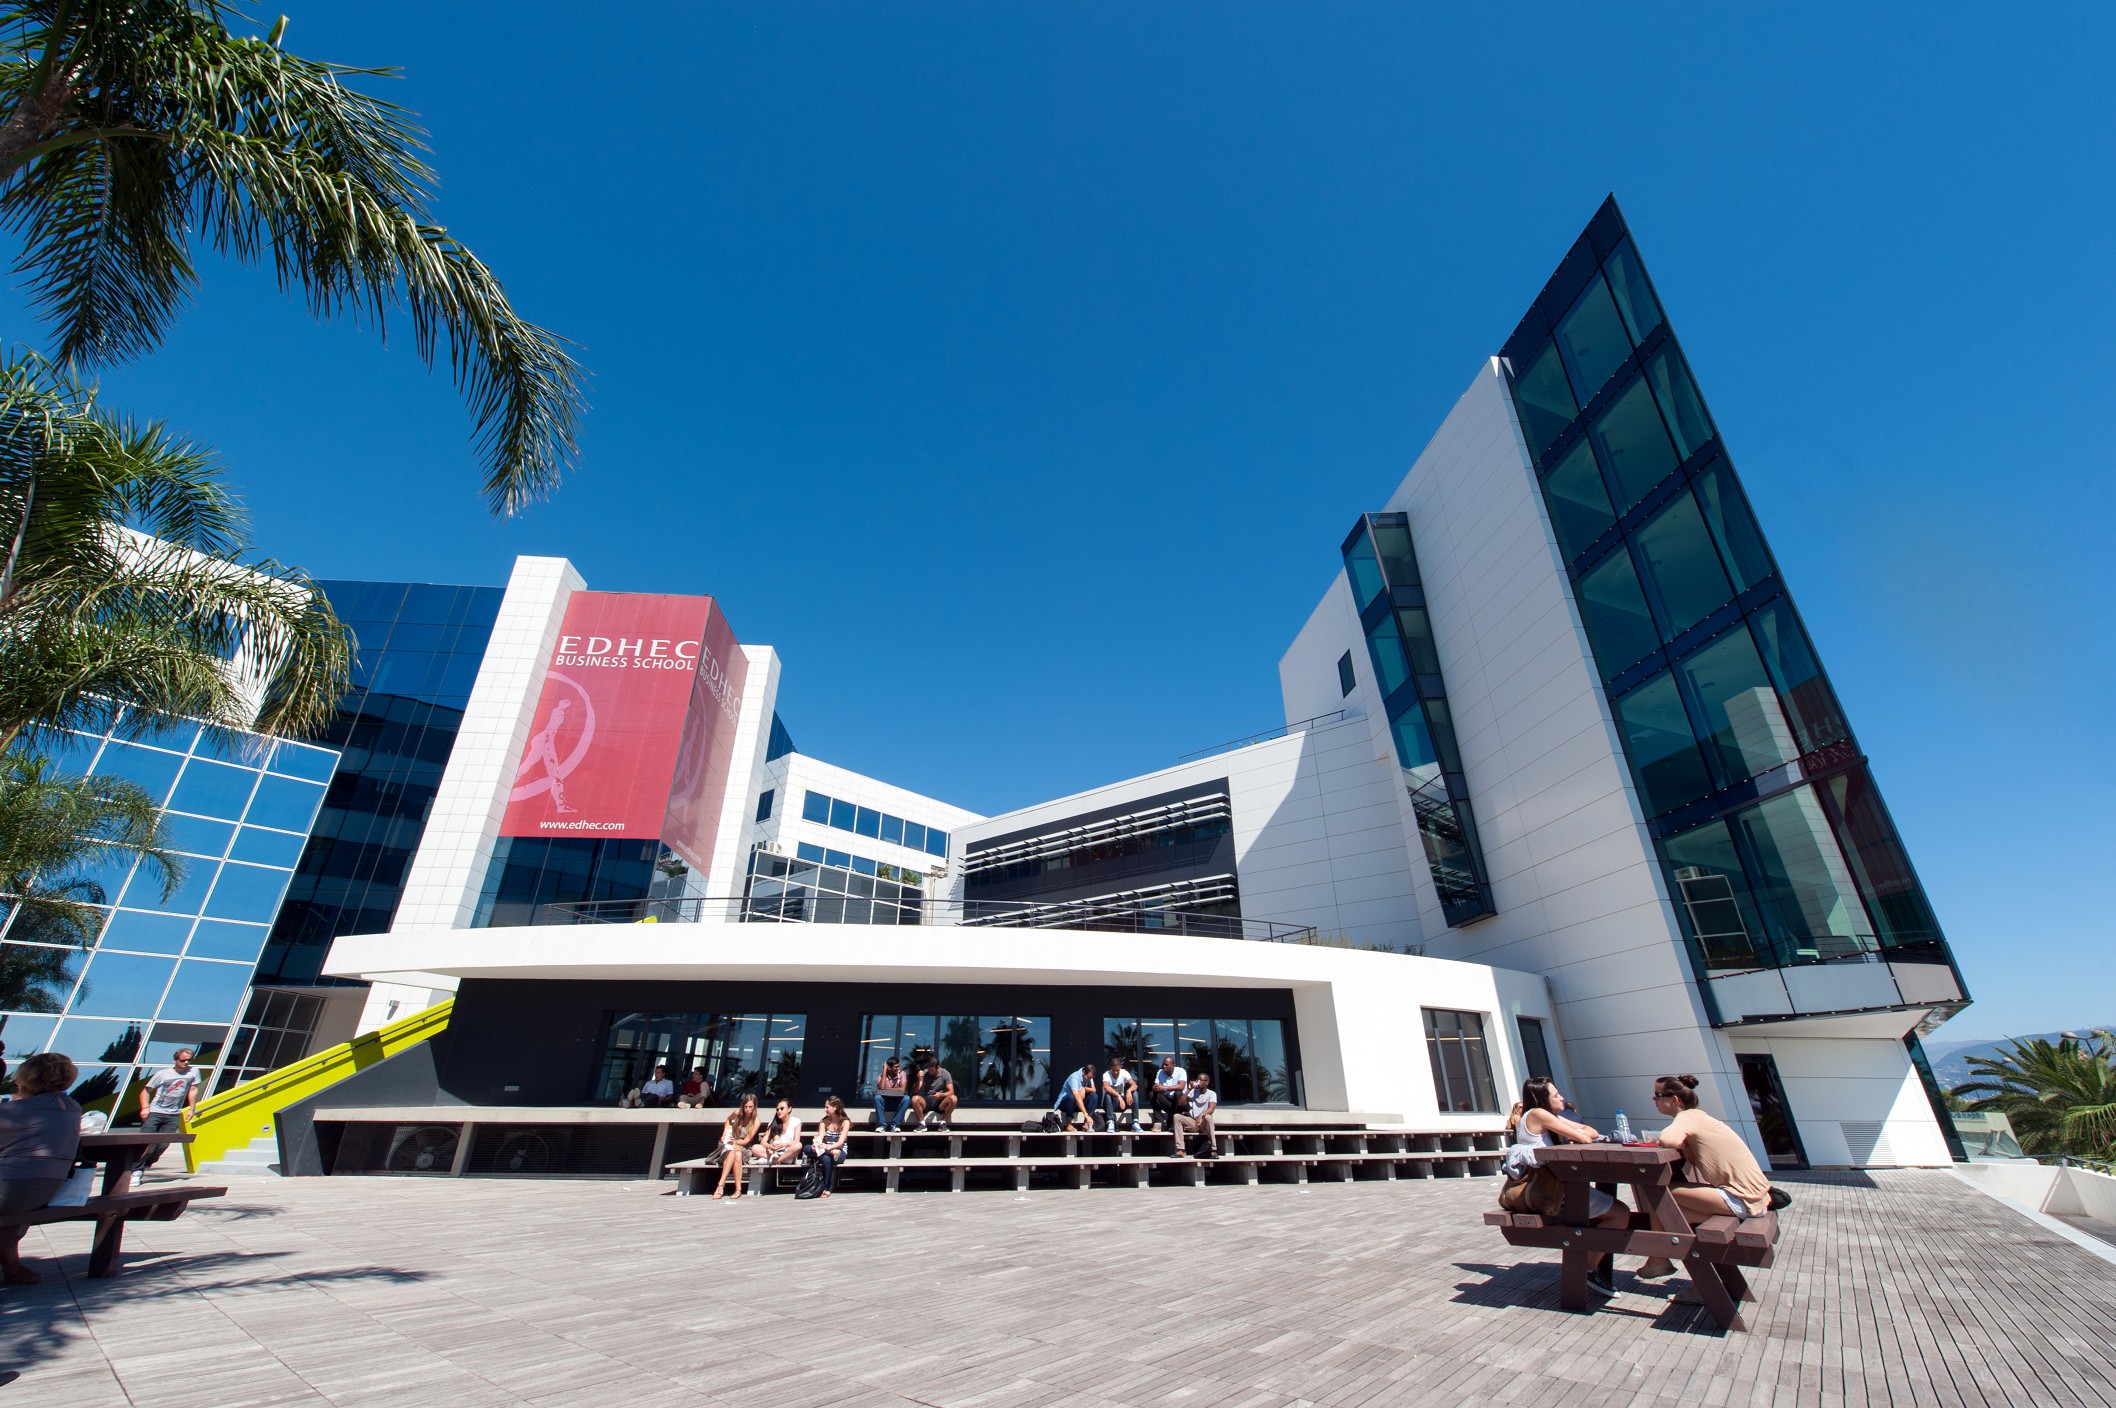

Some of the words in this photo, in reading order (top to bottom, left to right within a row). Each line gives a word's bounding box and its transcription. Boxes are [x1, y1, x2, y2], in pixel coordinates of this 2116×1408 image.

[559, 635, 699, 659] EDHEC
[555, 655, 628, 668] BUSINESS
[632, 659, 694, 671] SCHOOL
[700, 665, 721, 703] BUSINESS
[702, 645, 741, 717] EDHEC
[540, 820, 625, 830] www.edhec.com
